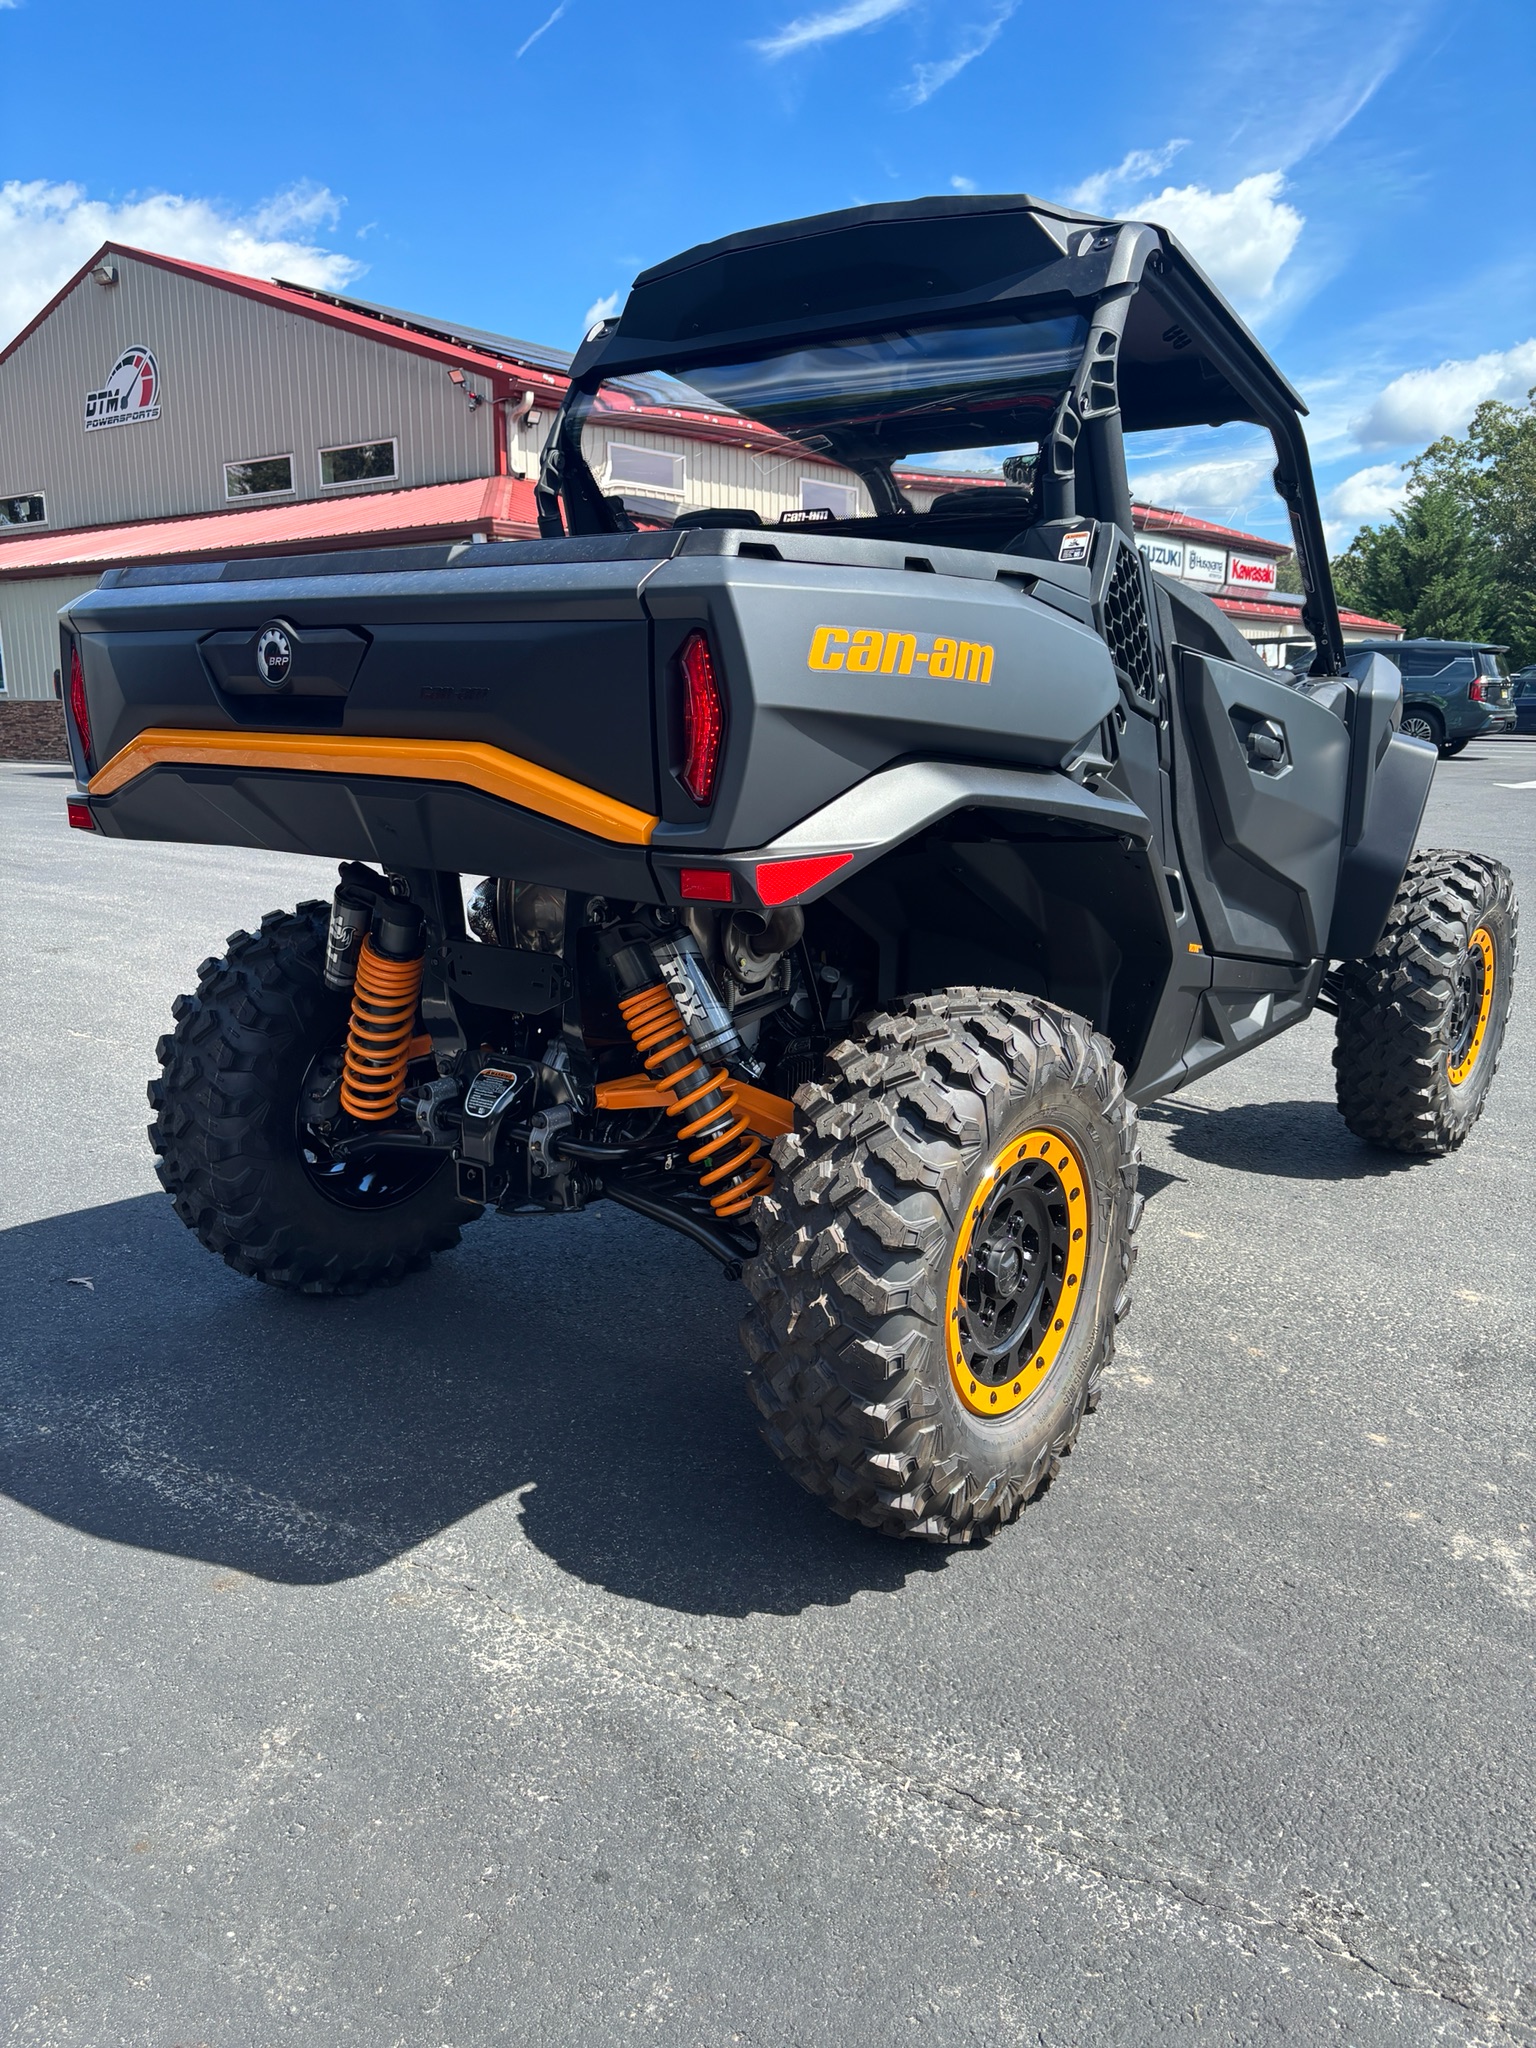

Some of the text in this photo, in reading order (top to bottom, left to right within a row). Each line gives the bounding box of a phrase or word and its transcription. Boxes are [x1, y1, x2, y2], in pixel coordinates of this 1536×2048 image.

[86, 389, 120, 418] DTM
[86, 408, 159, 429] POWERSPORTS
[1231, 558, 1275, 584] Kawasaki
[269, 656, 289, 666] BRP
[807, 626, 995, 684] can-am
[659, 956, 708, 1027] FOX
